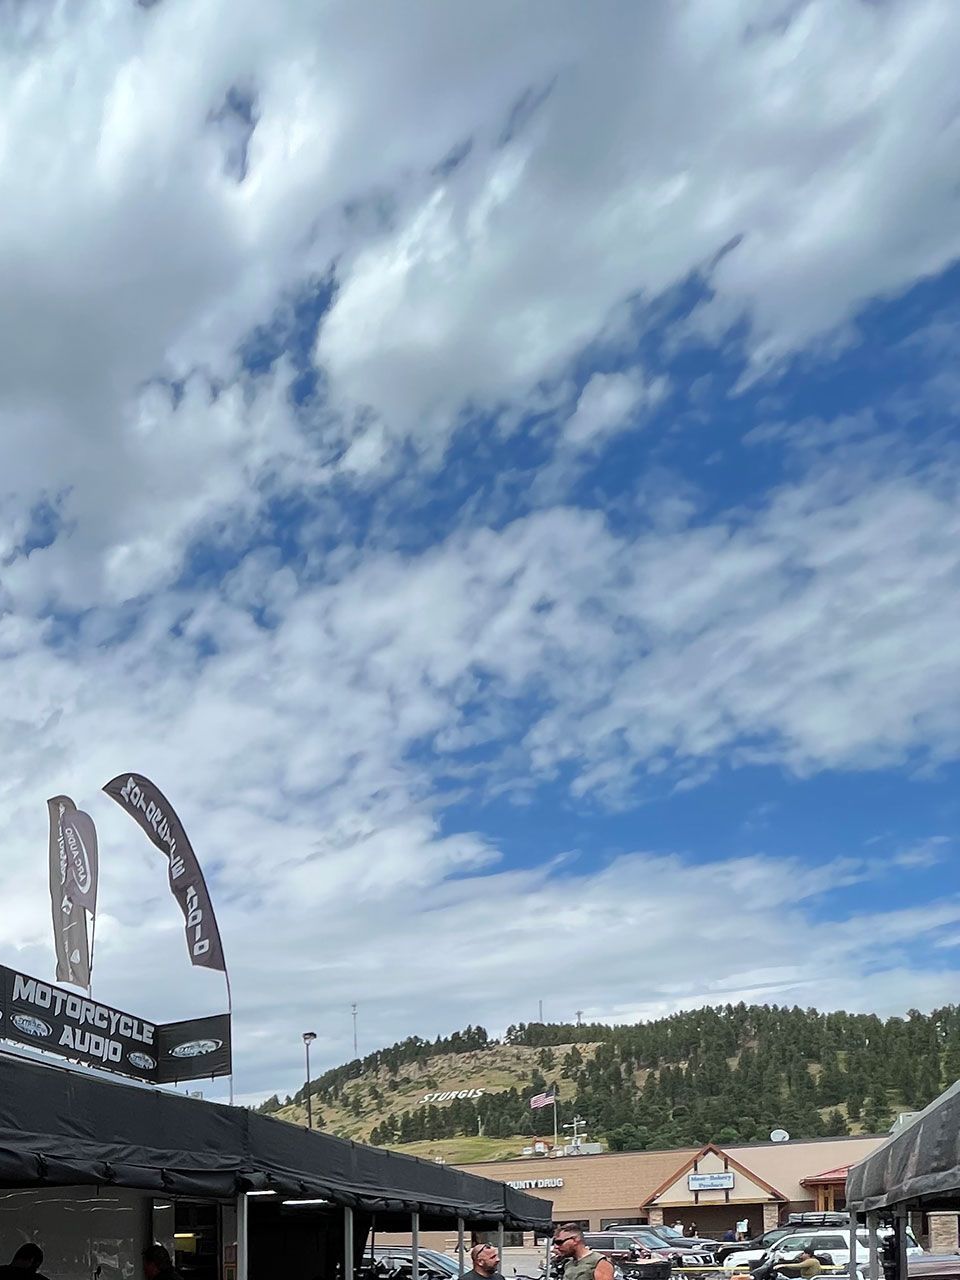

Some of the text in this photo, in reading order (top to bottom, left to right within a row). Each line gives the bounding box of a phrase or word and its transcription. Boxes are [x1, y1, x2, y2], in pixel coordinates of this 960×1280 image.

[185, 885, 210, 956] AUDIO
[12, 974, 156, 1045] MOTORCYCLE
[58, 1024, 122, 1063] AUDIO
[419, 1087, 486, 1104] STURGIS
[506, 1177, 564, 1190] OUNTY DRUG
